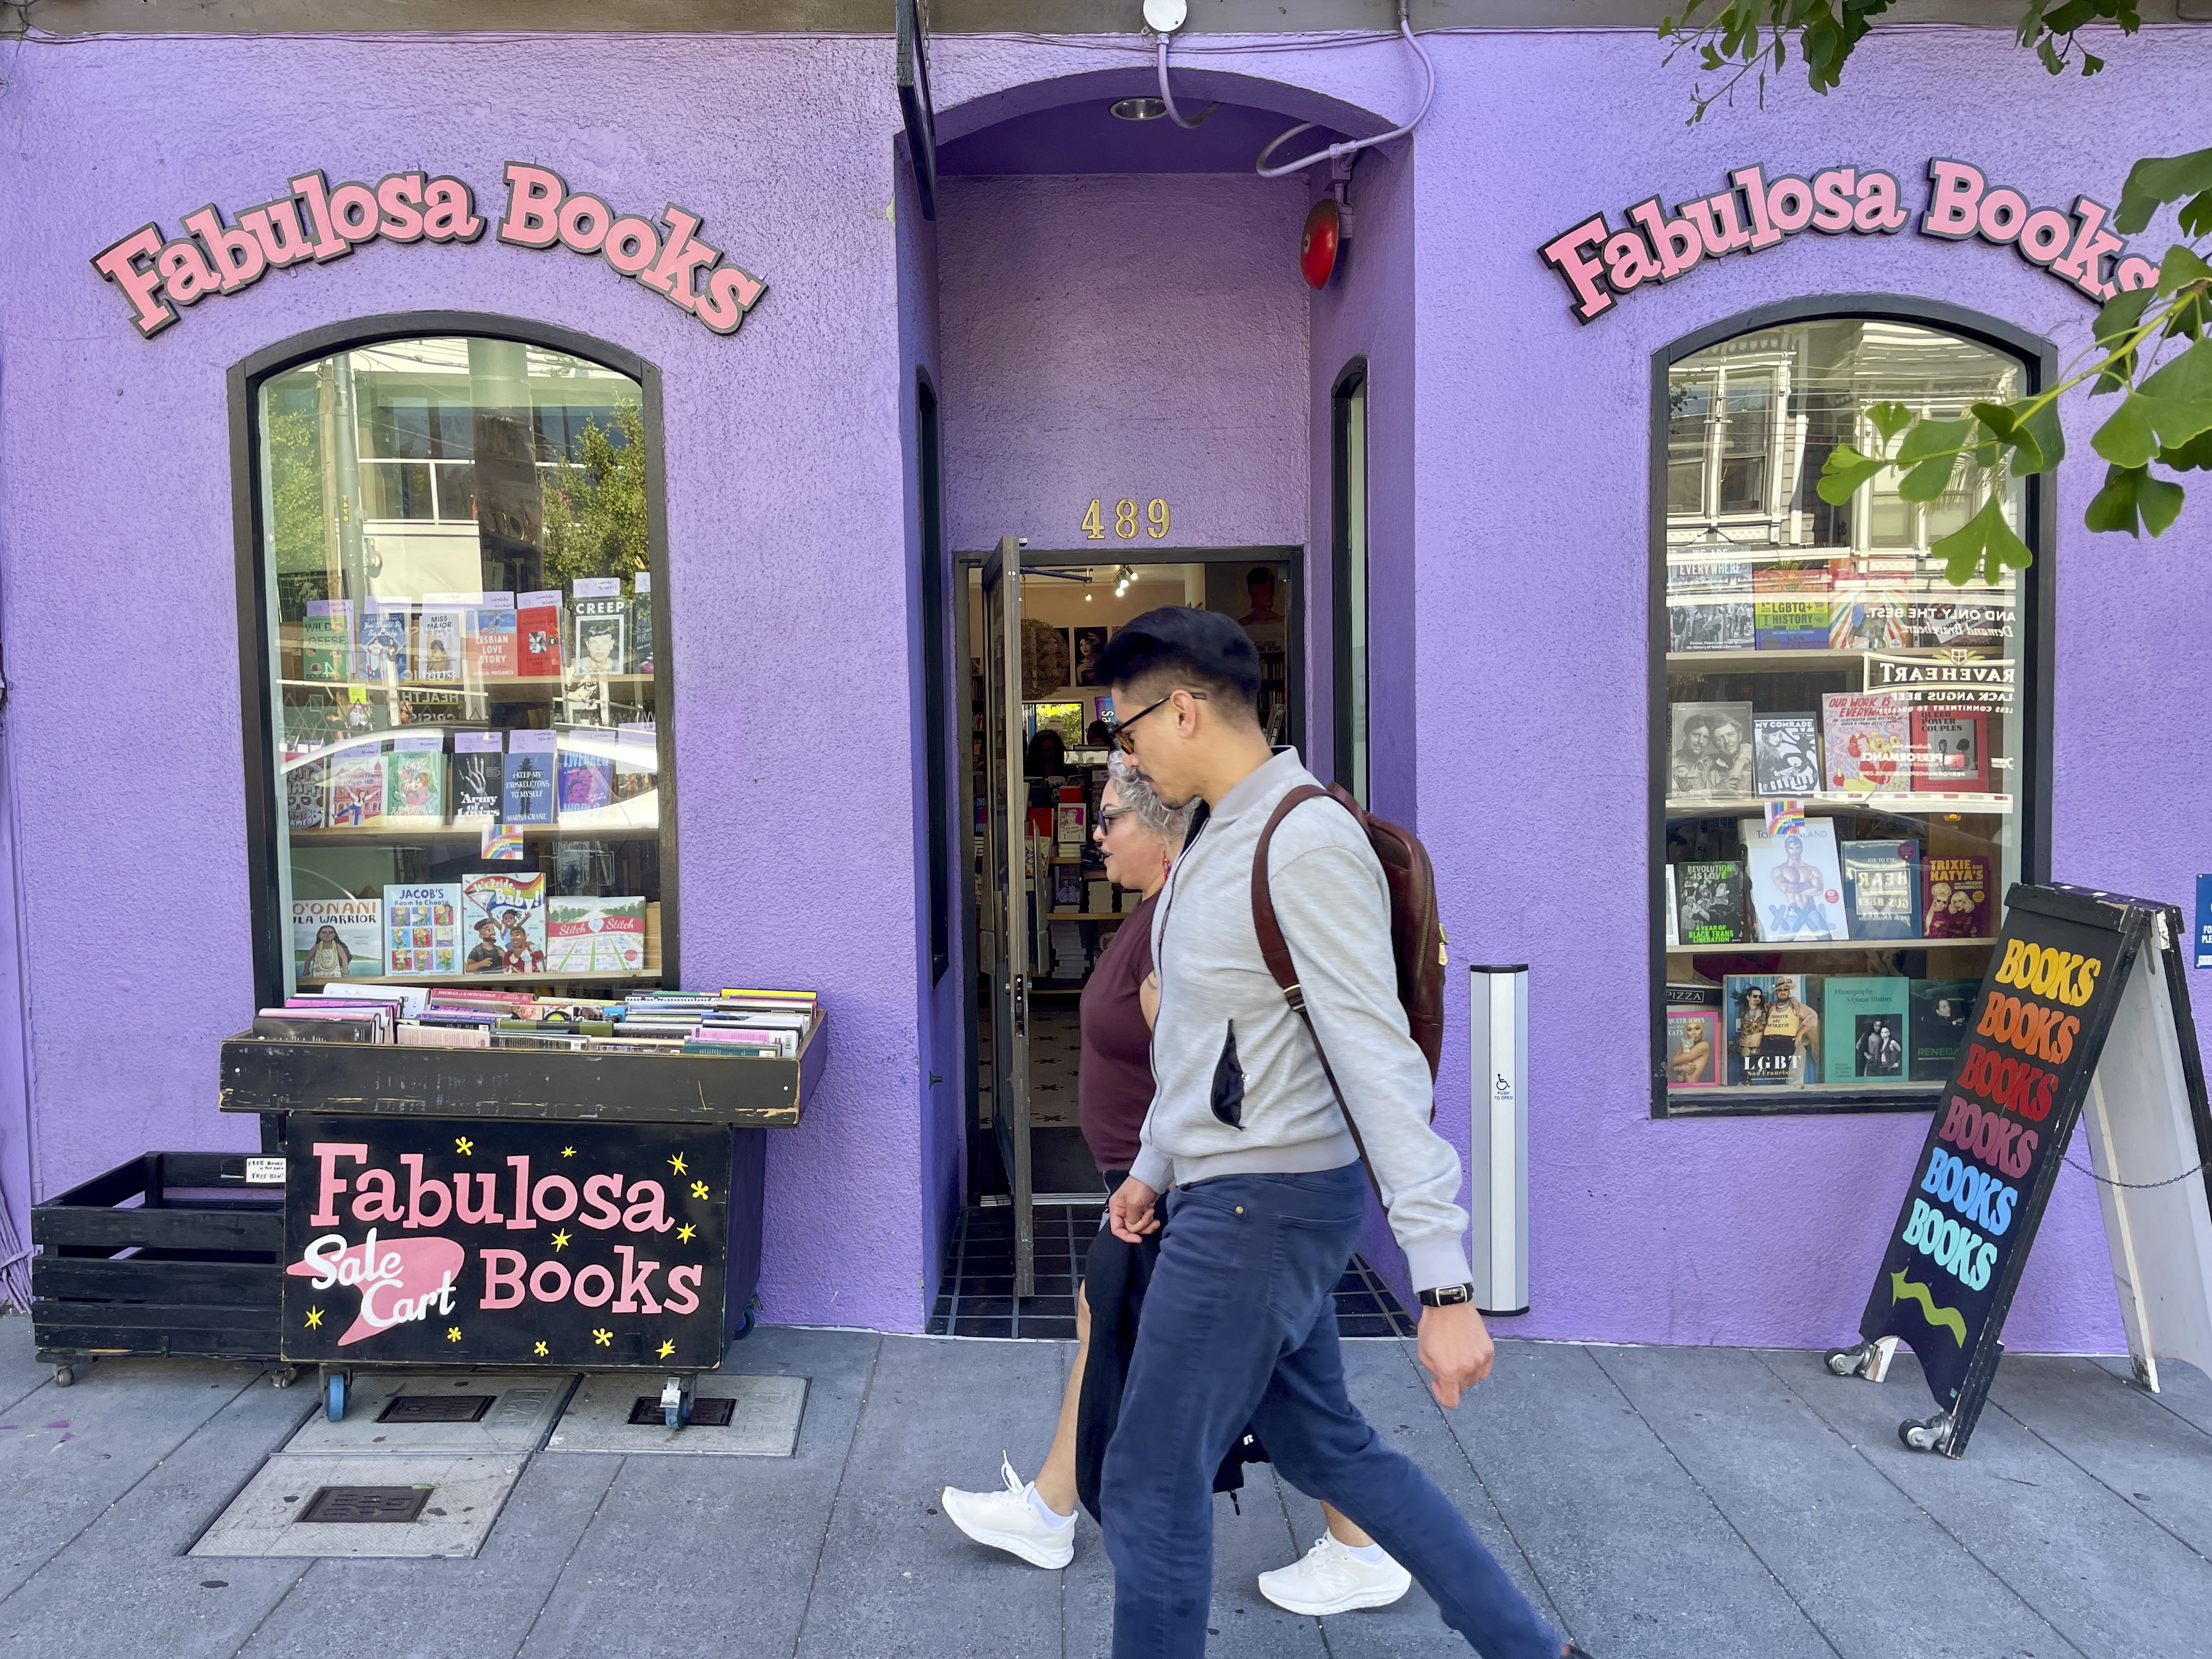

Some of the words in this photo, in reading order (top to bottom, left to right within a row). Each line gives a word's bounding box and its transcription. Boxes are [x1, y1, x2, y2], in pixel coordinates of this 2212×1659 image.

[91, 170, 486, 337] Fabulosa
[498, 160, 768, 336] Books
[1537, 162, 1911, 326] Fabulosa
[1081, 498, 1171, 539] 489
[1680, 562, 1742, 575] EVERYWHERE
[576, 601, 624, 614] CREEP
[1772, 602, 1813, 613] LGBTQ+
[1773, 614, 1813, 624] HISTORY
[305, 623, 332, 632] WILD
[476, 635, 508, 644] LESBIAN
[479, 655, 506, 663] STORY
[1829, 698, 1847, 708] OUR
[1850, 697, 1878, 707] WORK
[1881, 697, 1891, 706] IS
[405, 760, 427, 770] ONLY
[506, 780, 550, 788] EXOSKELETONS
[461, 792, 498, 805] Army
[1688, 865, 1733, 873] REVOLUTION
[1930, 860, 1971, 871] TRIXIE
[1931, 870, 1984, 881] KATYA'S
[473, 880, 489, 893] It's
[399, 889, 444, 899] JACOB'S
[495, 887, 539, 912] Baby!
[320, 915, 376, 924] WARRIOR
[1769, 903, 1836, 932] XXL
[560, 923, 586, 936] Stitch
[606, 918, 635, 930] Stitch
[1996, 938, 2101, 1007] BOOKS
[1835, 988, 1873, 996] Photography
[1977, 991, 2080, 1064] BOOKS
[1744, 1055, 1801, 1070] LGBT
[1959, 1043, 2058, 1121] BOOKS
[1939, 1096, 2038, 1179] BOOKS
[311, 1142, 675, 1233] Fabulosa
[1921, 1147, 2018, 1236] BOOKS
[1903, 1198, 1997, 1290] BOOKS
[304, 1228, 403, 1291] Sale
[479, 1245, 702, 1315] Books
[360, 1270, 456, 1329] Cart
